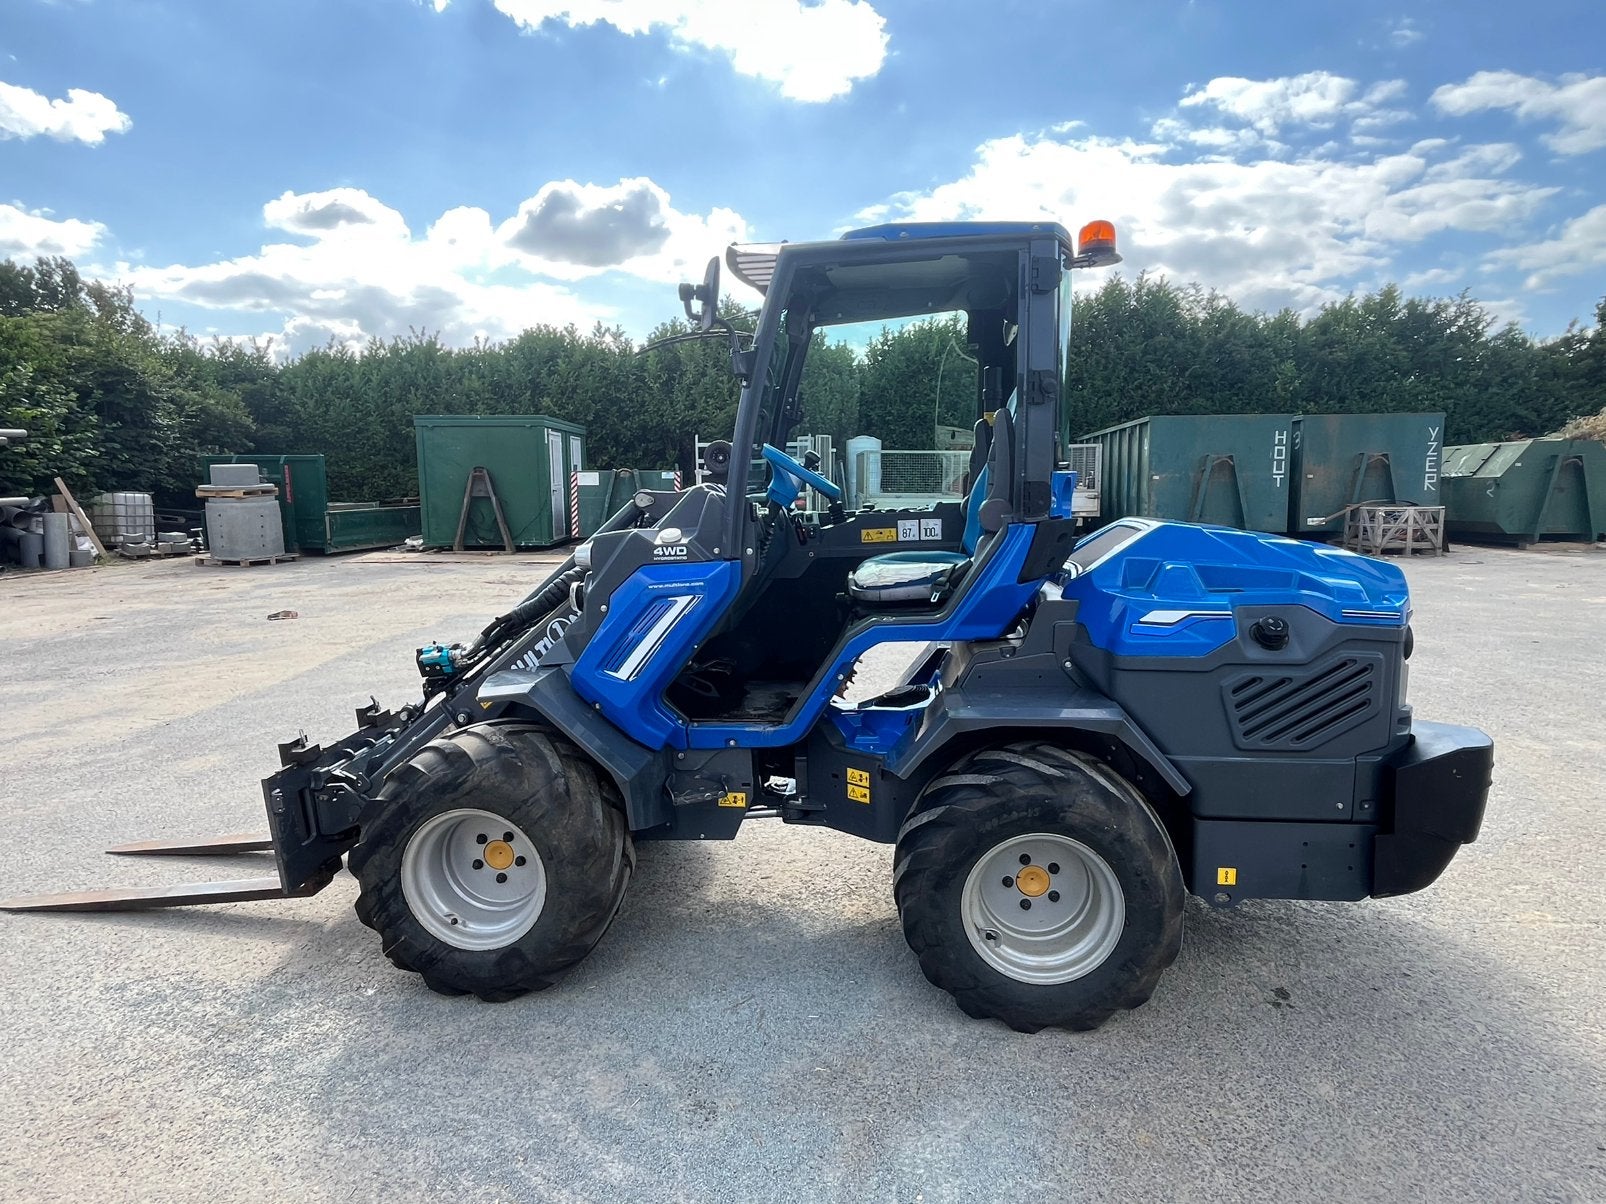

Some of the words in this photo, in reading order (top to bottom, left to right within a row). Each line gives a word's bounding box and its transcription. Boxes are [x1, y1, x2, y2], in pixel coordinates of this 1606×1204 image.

[1272, 430, 1287, 488] HOUT
[1423, 426, 1440, 491] YZER
[902, 527, 912, 538] 87
[923, 526, 936, 538] 100
[653, 546, 687, 556] 4WD
